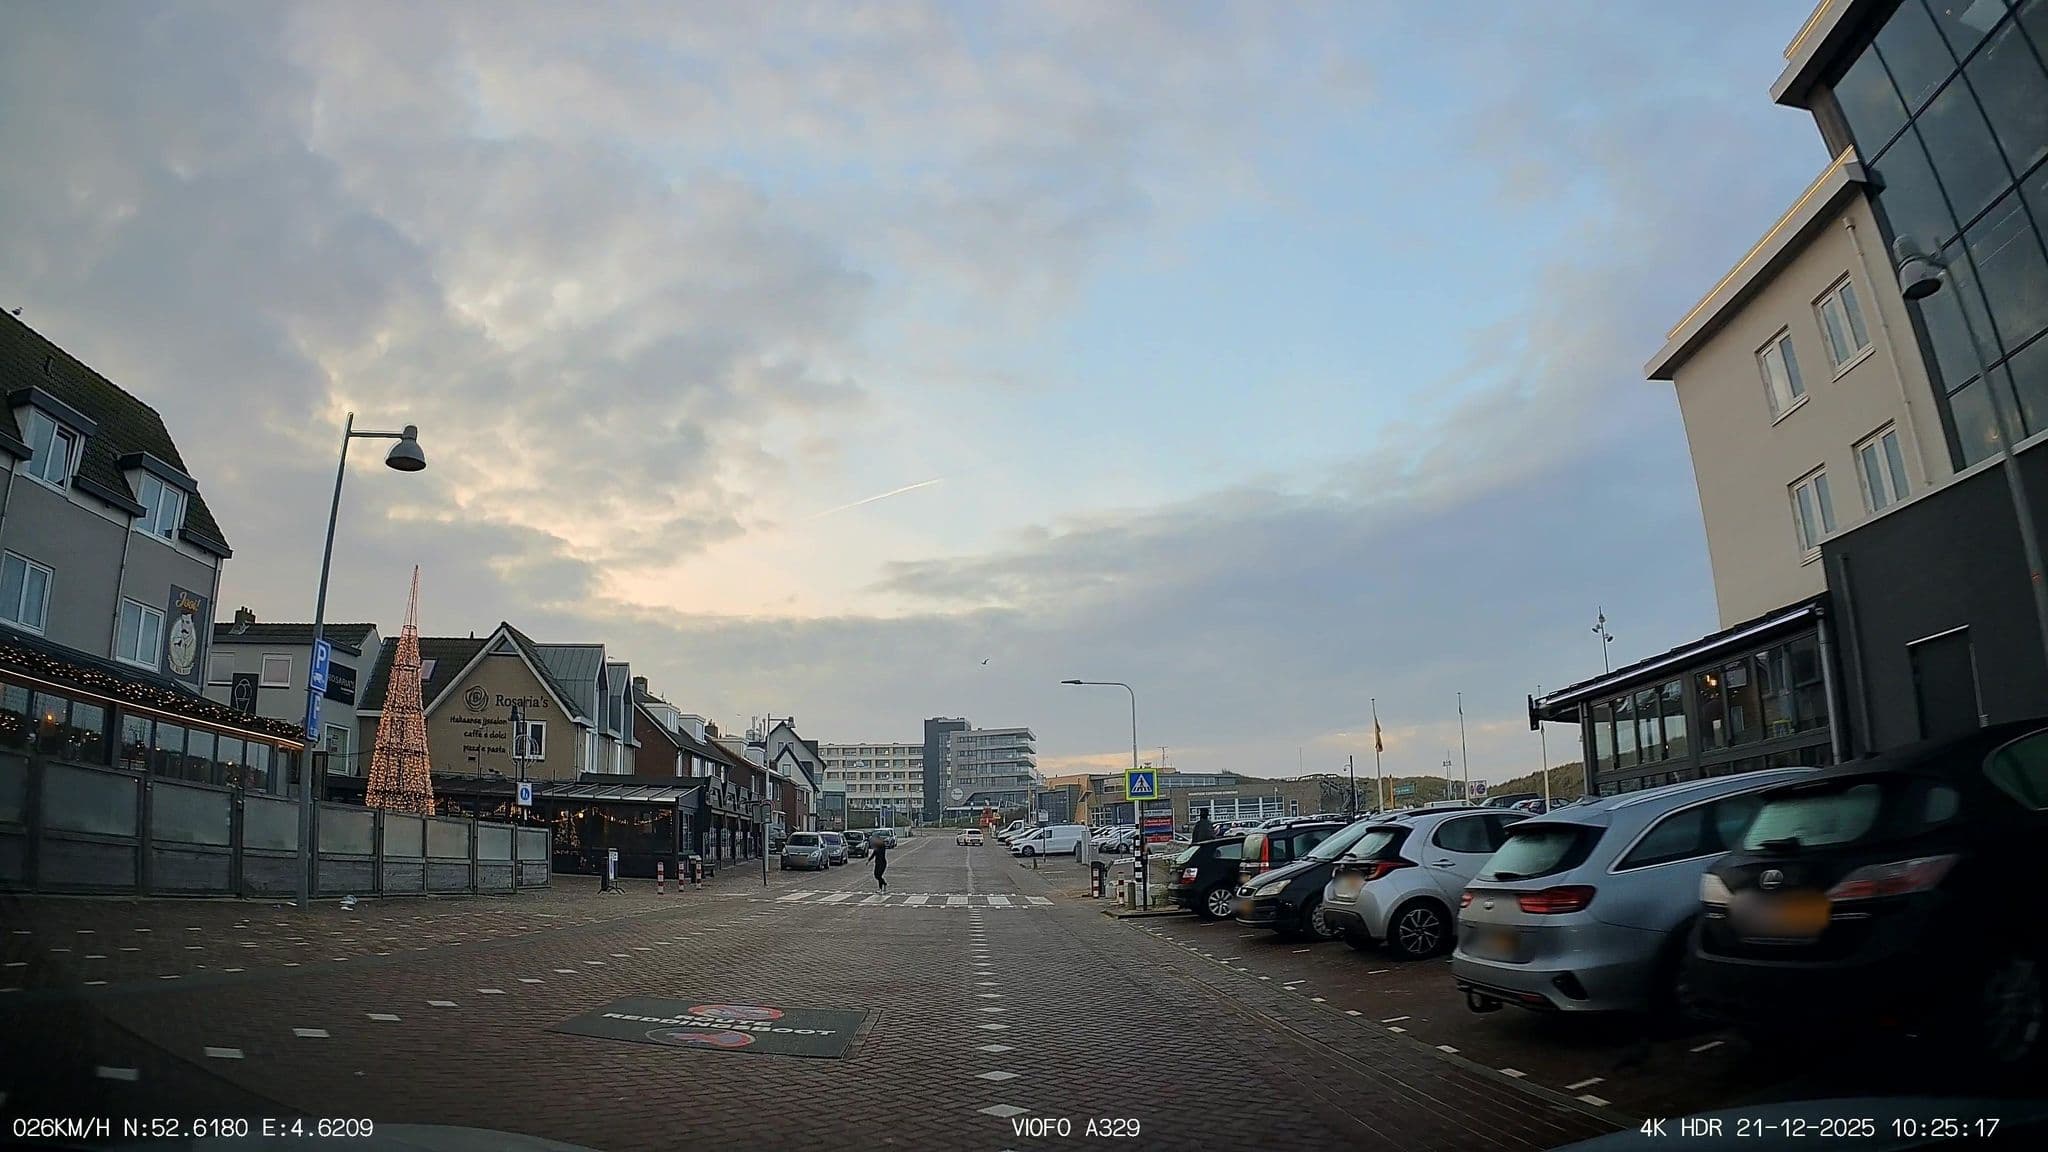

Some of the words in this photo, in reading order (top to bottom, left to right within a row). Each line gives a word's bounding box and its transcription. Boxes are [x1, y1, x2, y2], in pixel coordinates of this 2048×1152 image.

[316, 645, 327, 669] P
[495, 694, 549, 708] Rosaria's
[489, 730, 507, 739] dolci
[674, 1014, 774, 1027] ROUTE
